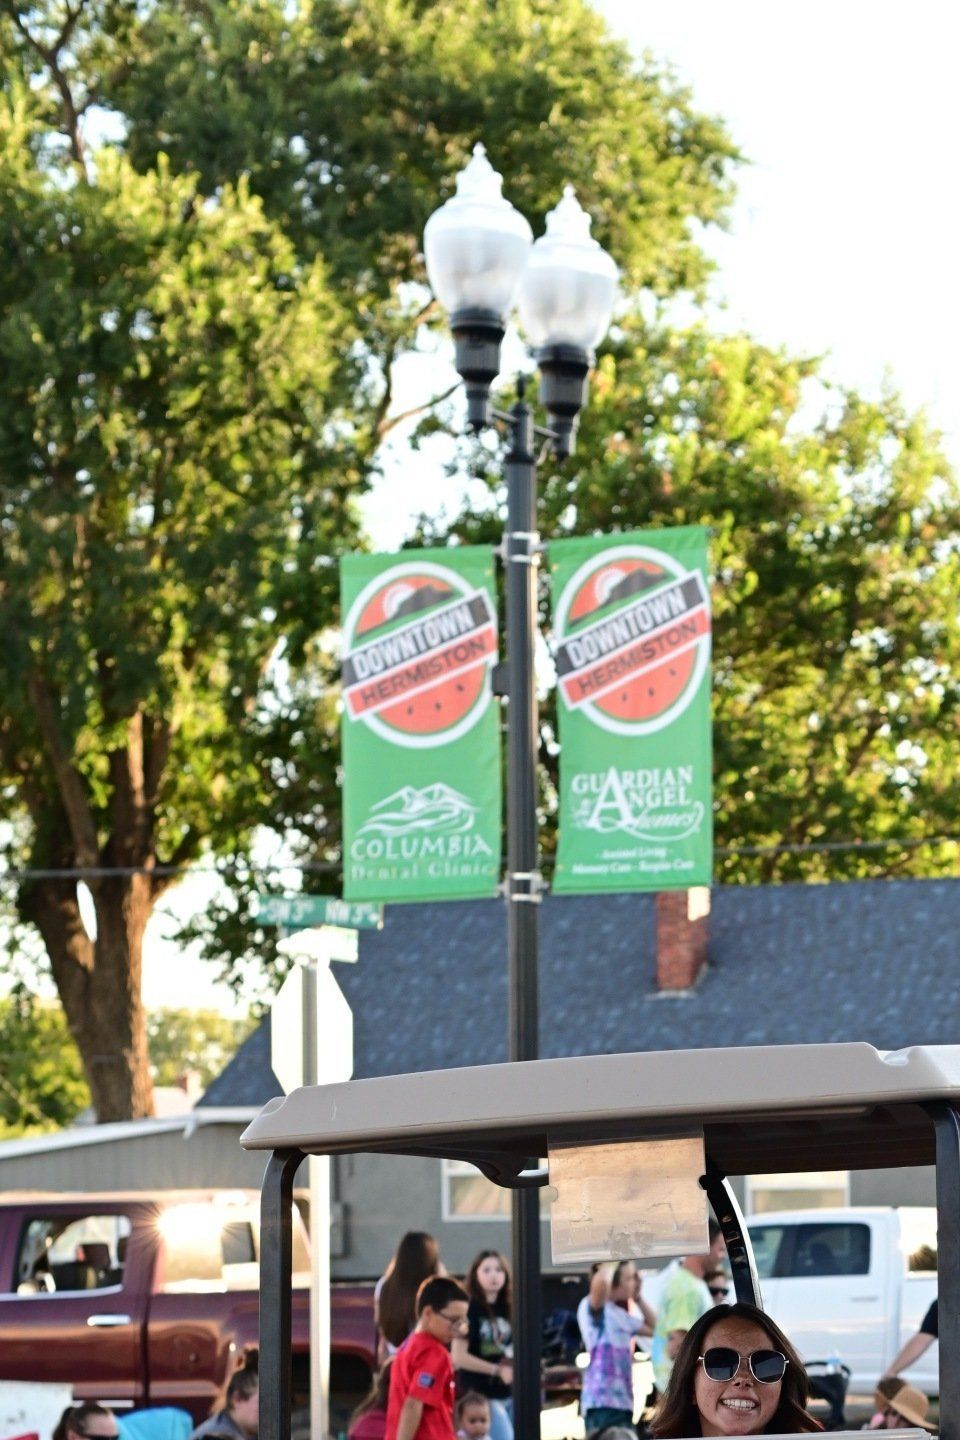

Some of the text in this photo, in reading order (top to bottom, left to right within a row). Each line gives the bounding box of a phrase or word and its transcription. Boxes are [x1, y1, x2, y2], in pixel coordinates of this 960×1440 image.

[352, 603, 475, 681] DOWNTOWN
[566, 586, 688, 669] DOWNTOWN
[577, 618, 697, 695] HERMISTON
[360, 636, 486, 706] HERMISTON
[571, 766, 694, 800] GUARDIAN
[350, 834, 494, 861] COLUMBIA
[351, 859, 494, 880] Dental Clinic
